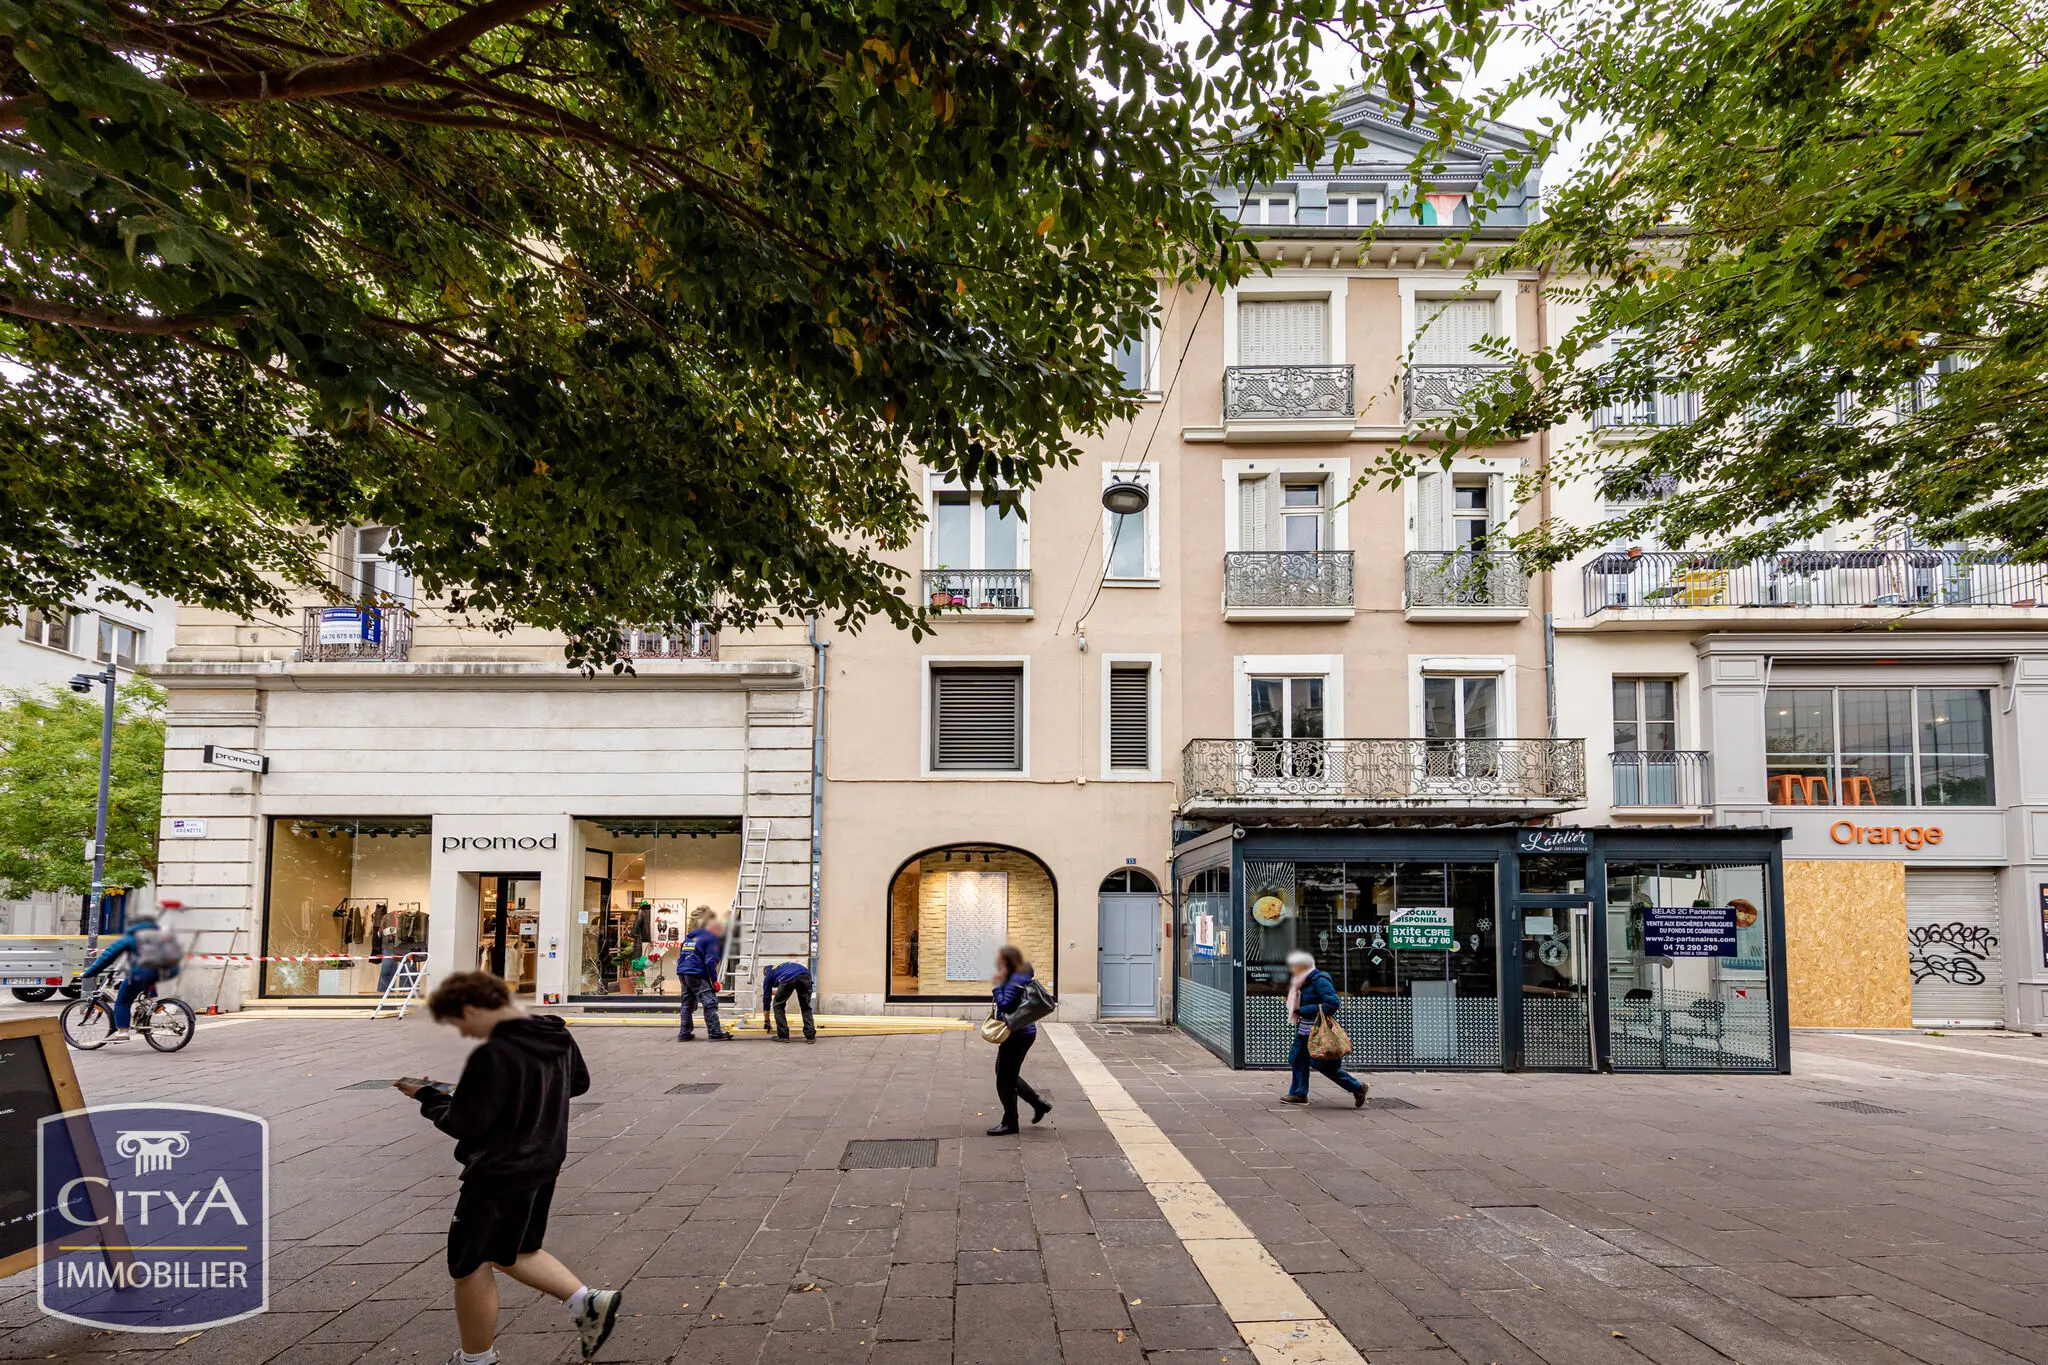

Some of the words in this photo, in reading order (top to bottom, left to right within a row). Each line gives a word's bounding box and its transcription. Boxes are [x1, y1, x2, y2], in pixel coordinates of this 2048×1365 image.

[215, 752, 260, 766] promod
[1830, 820, 1944, 850] Orange
[442, 832, 557, 853] promod
[1336, 925, 1368, 933] SALON
[1369, 925, 1383, 933] DE
[1392, 927, 1421, 936] axite
